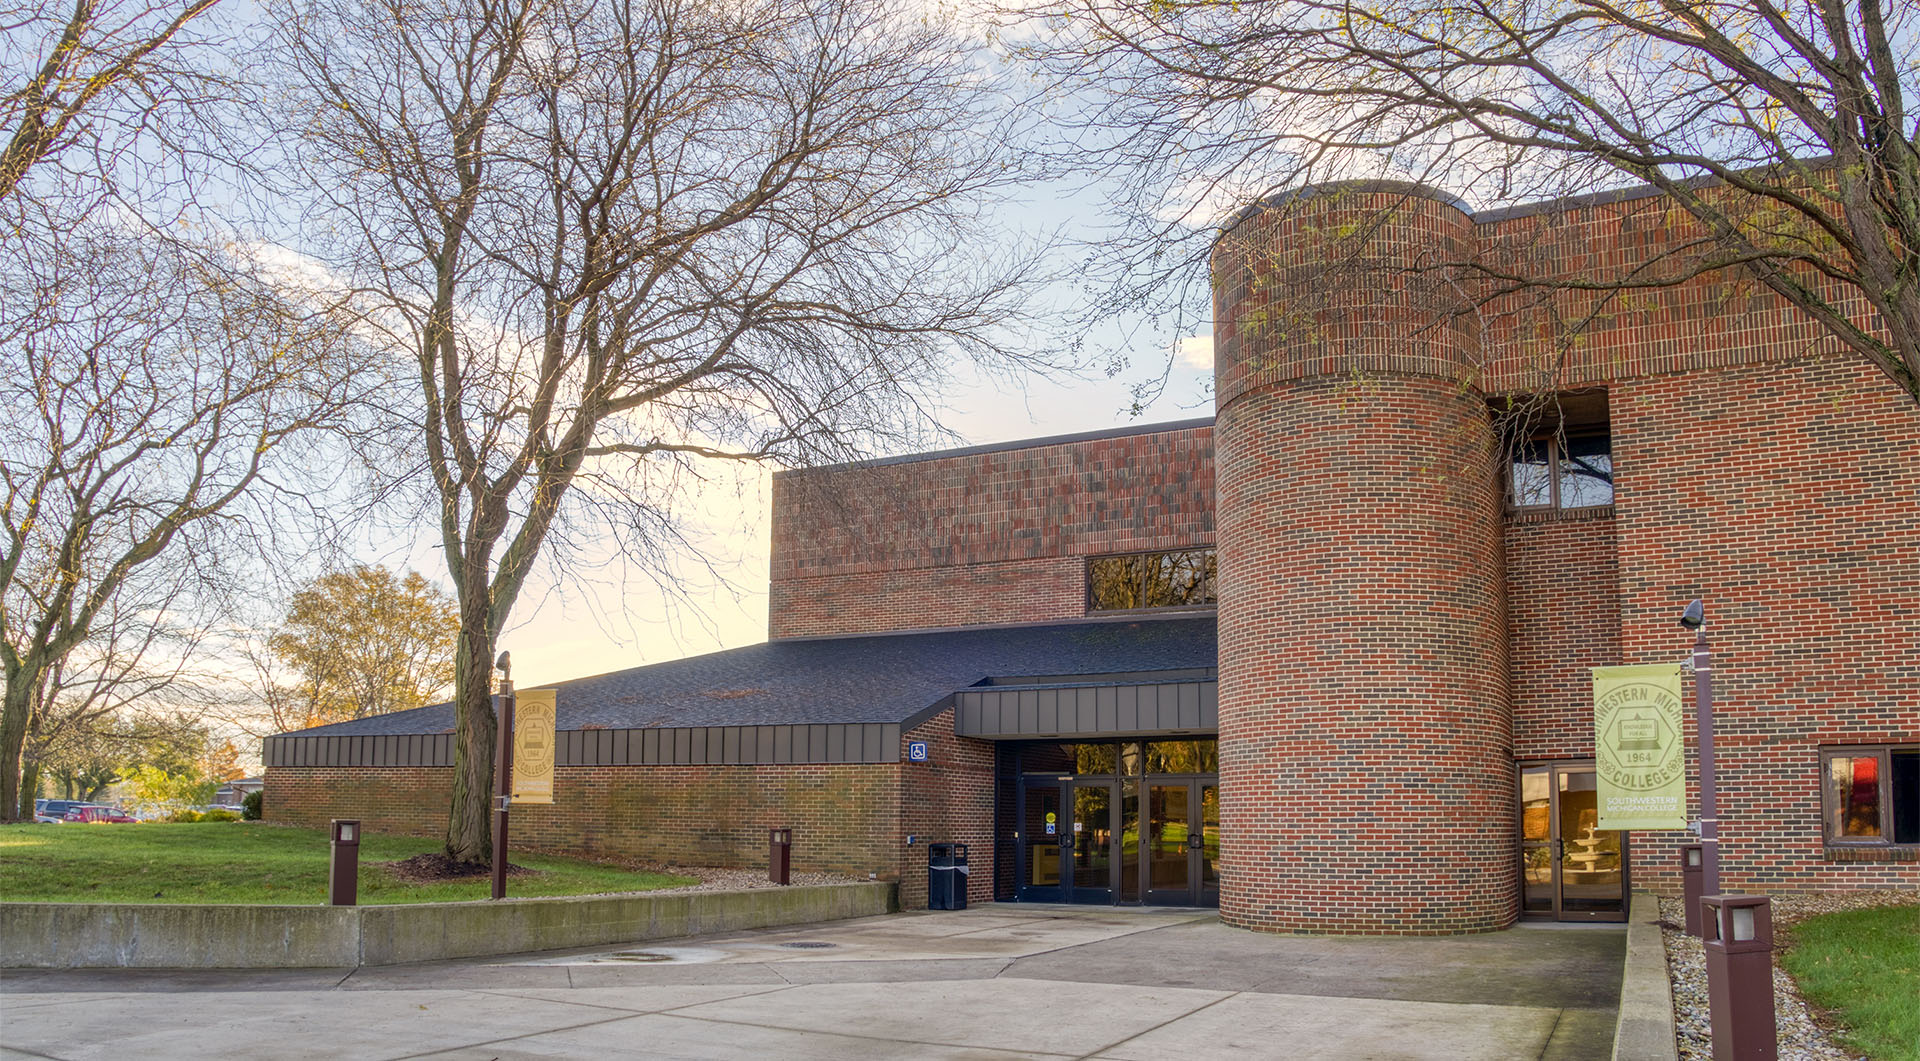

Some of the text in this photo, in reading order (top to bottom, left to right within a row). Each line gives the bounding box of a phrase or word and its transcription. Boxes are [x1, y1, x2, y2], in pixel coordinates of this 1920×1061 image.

[1627, 752, 1652, 763] 1964
[1613, 768, 1670, 787] COLLEGE
[1606, 797, 1677, 805] SOUTHWESTERN
[1606, 804, 1677, 812] MICHIGAN COLLEGE
